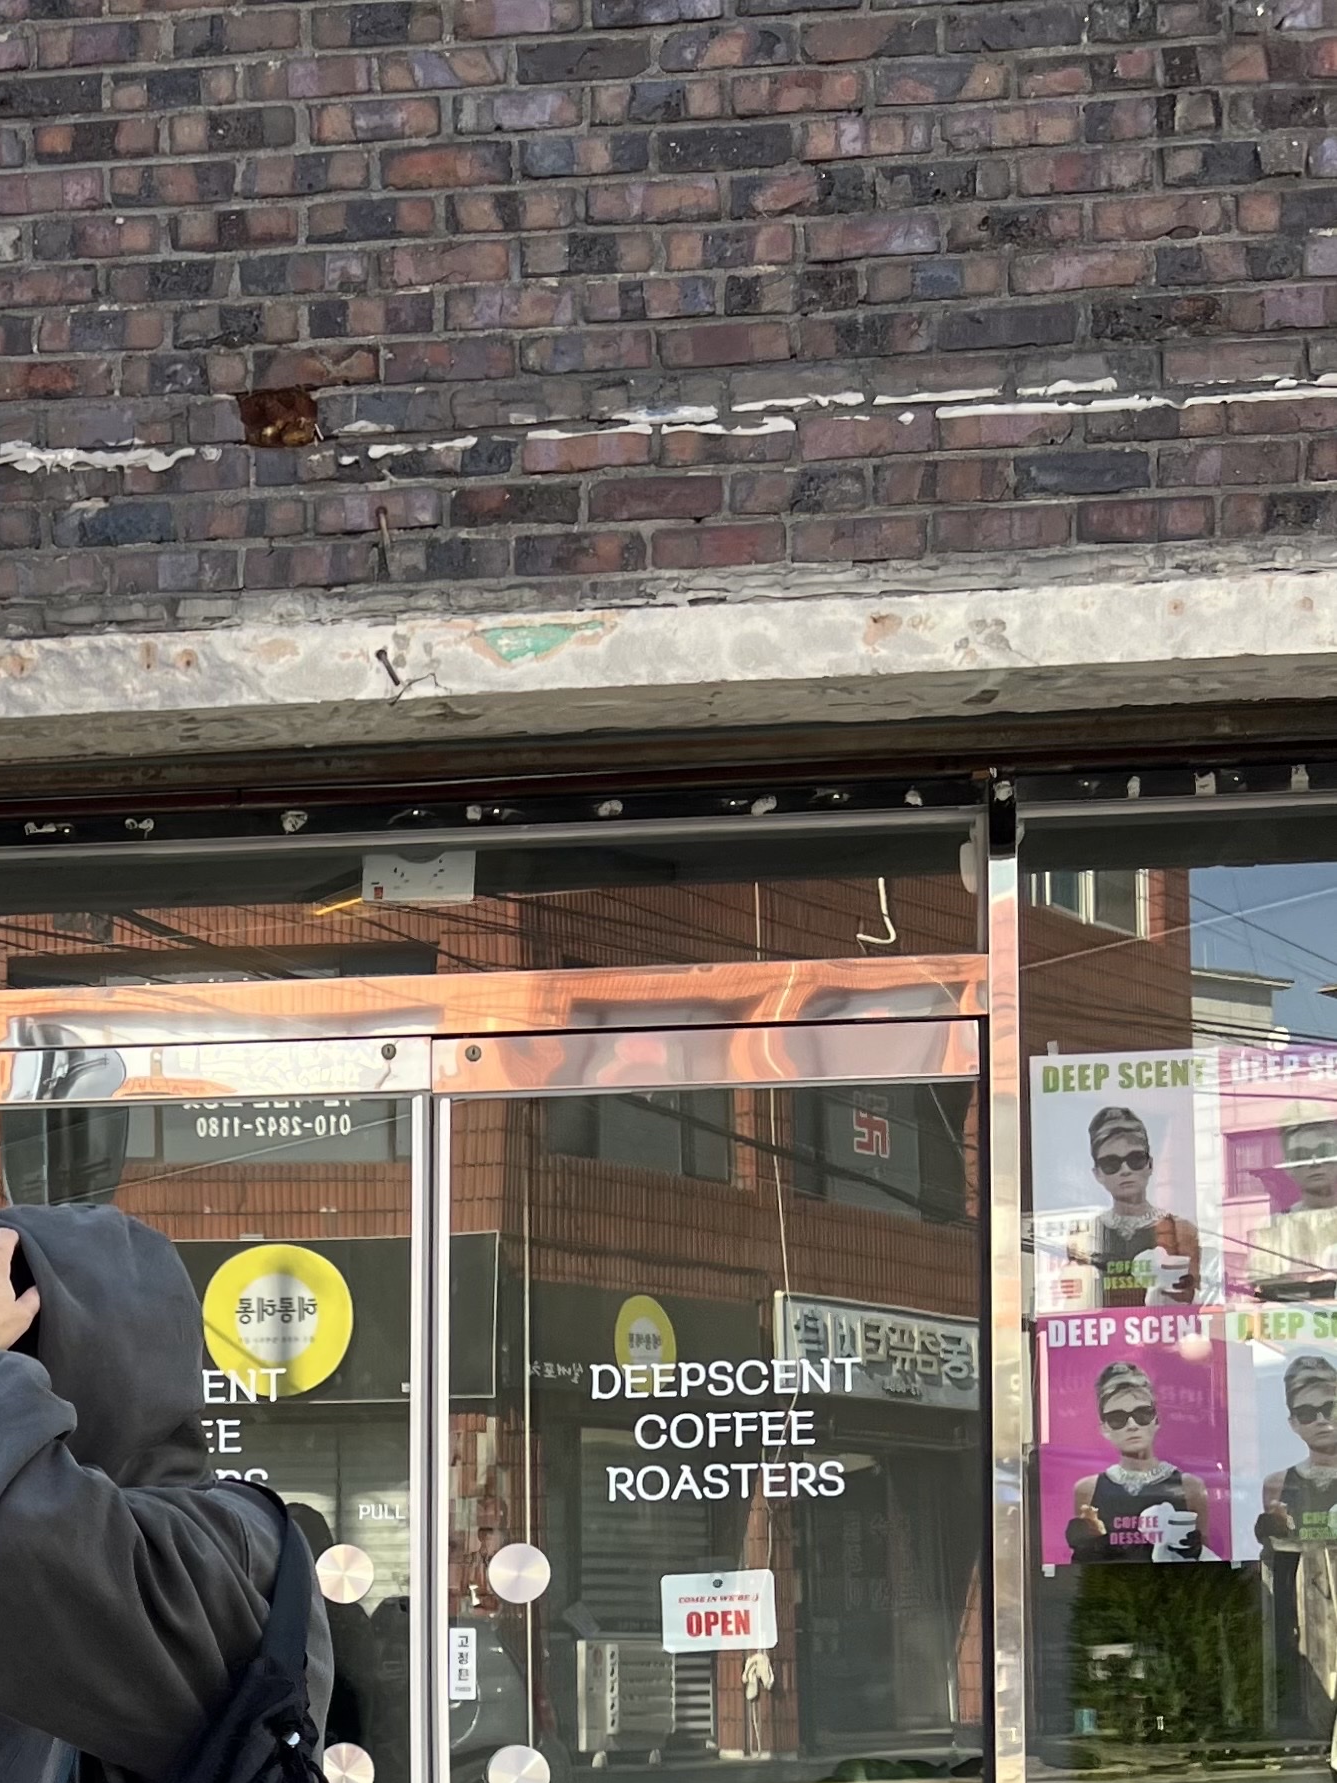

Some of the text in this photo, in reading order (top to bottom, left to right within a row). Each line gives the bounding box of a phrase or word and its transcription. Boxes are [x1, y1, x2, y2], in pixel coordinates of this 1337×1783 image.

[1041, 1057, 1208, 1094] DEEP SCENT
[1107, 1260, 1152, 1274] COFFEE
[1047, 1313, 1215, 1348] DEEP SCENT
[588, 1357, 863, 1401] DEEPSCENT
[634, 1410, 817, 1450] COFFEE
[607, 1462, 847, 1502] ROASTERS
[358, 1503, 406, 1520] PULL
[1113, 1515, 1160, 1529] COFFEE
[686, 1610, 751, 1637] OPEN
